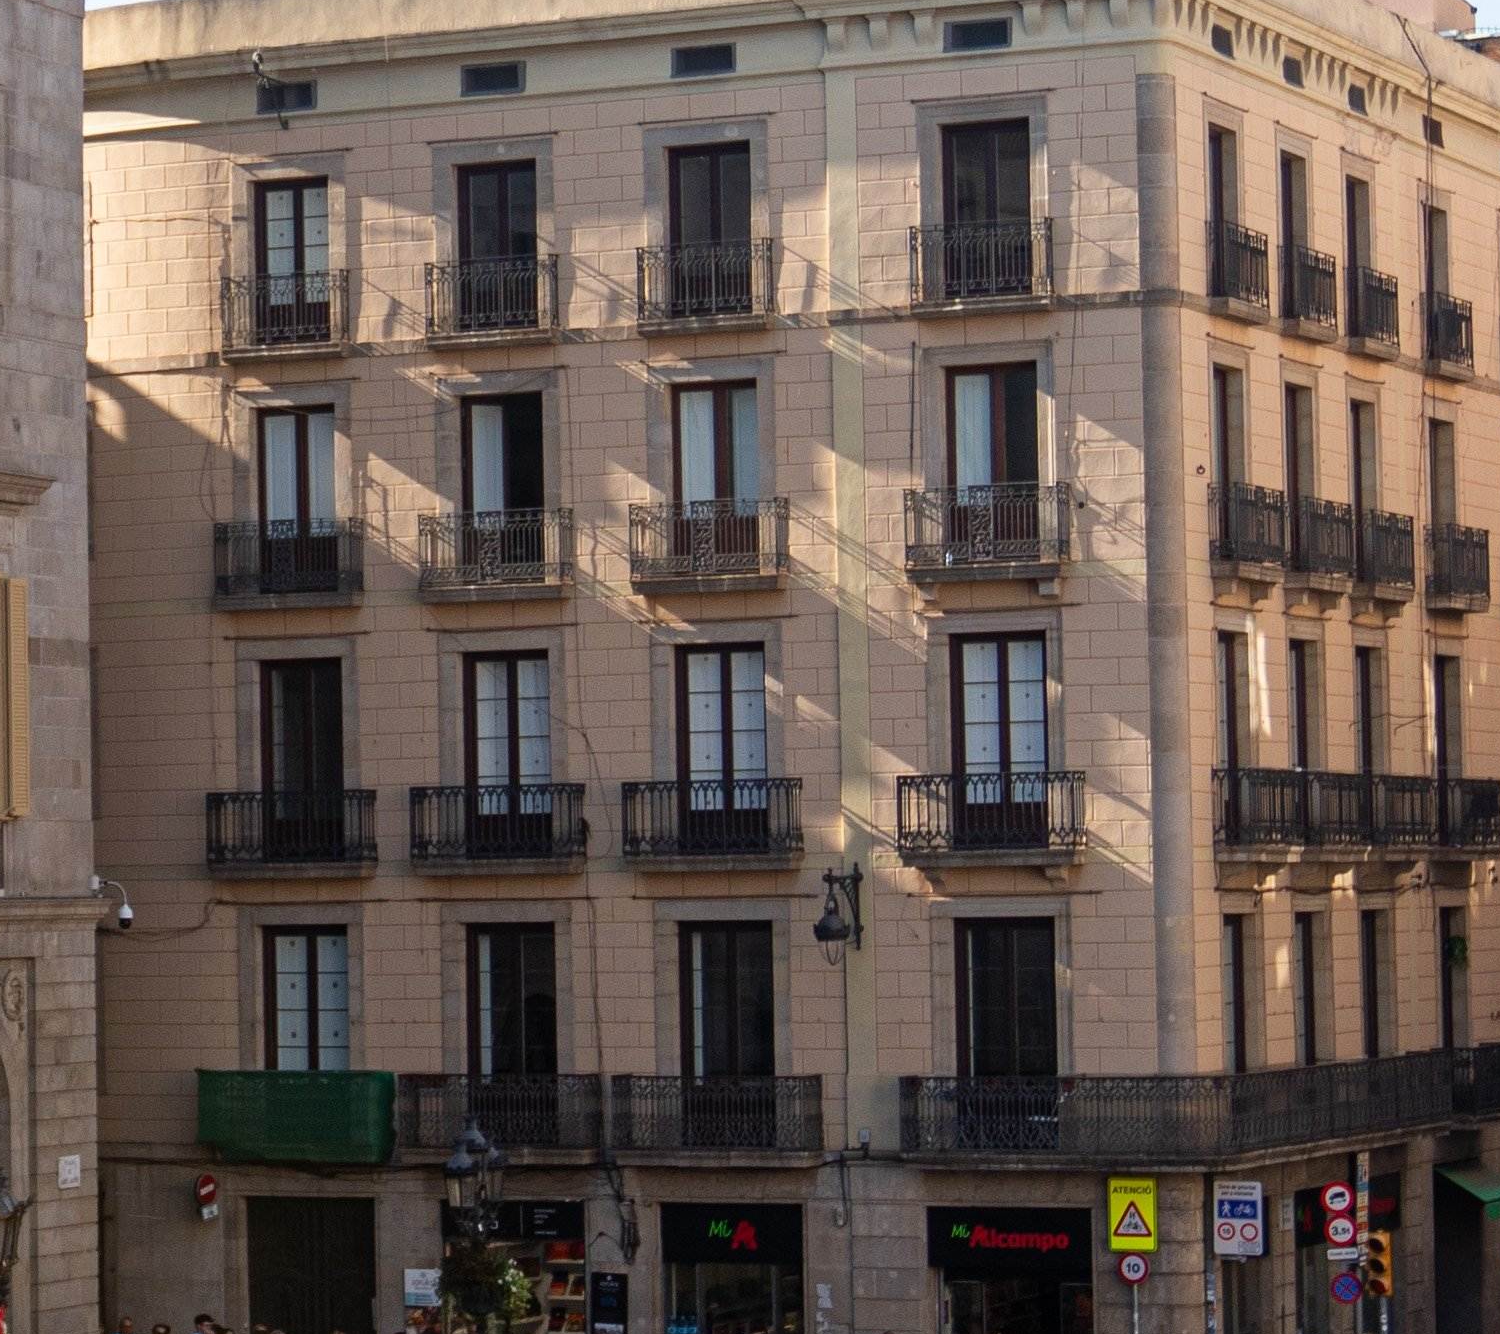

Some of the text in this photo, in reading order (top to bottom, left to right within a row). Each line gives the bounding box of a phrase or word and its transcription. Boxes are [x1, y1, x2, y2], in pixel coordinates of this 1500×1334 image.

[1112, 1185, 1152, 1194] ATENCIÓ
[969, 1225, 1069, 1252] Alcampo
[1125, 1262, 1140, 1274] 10
